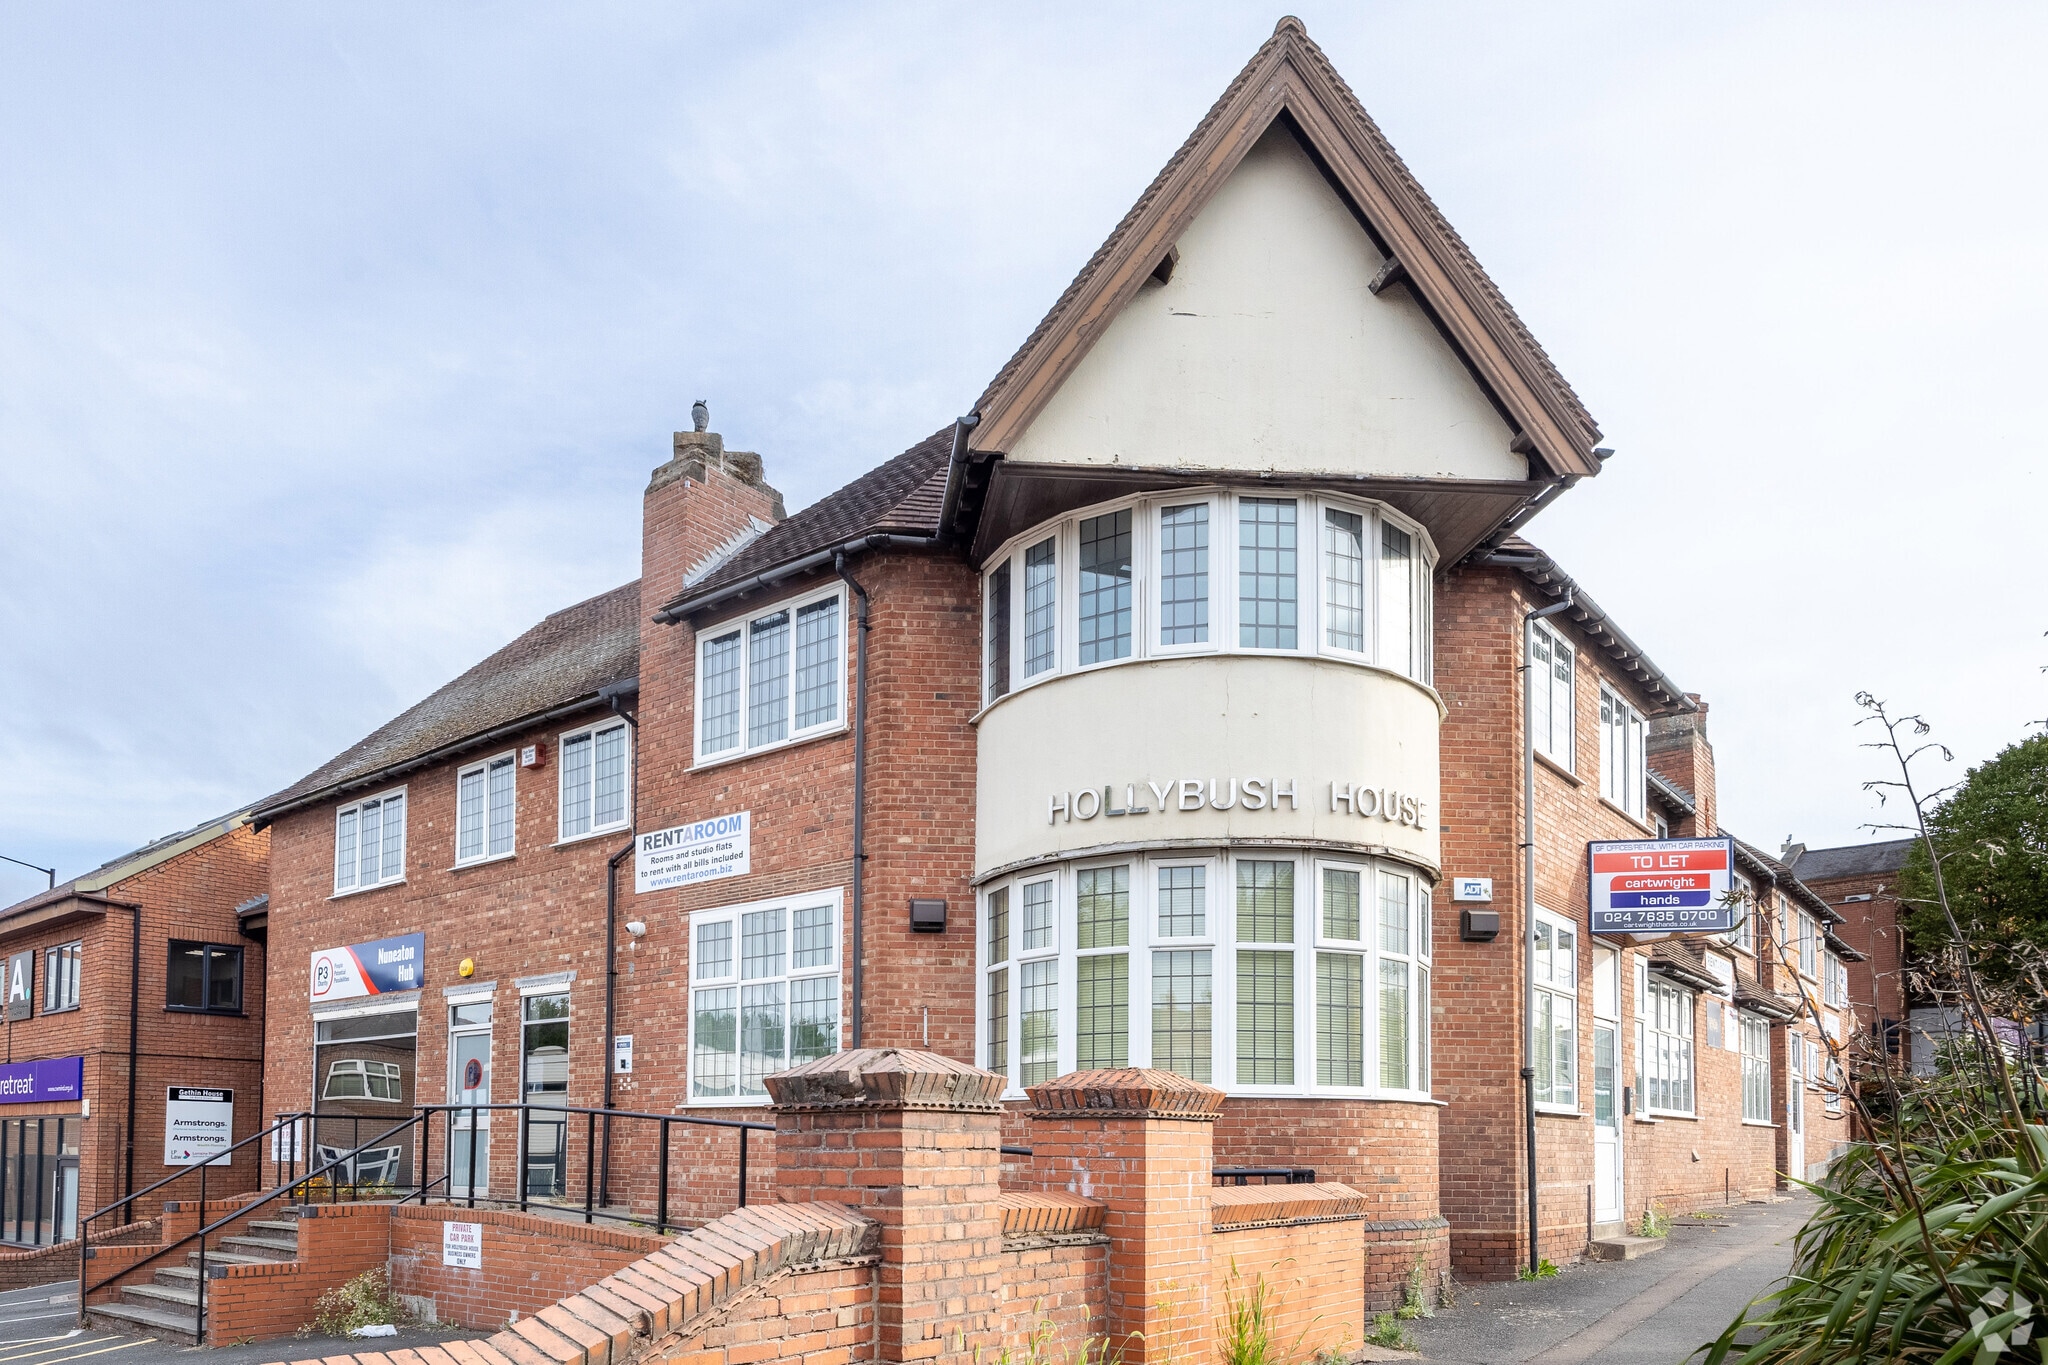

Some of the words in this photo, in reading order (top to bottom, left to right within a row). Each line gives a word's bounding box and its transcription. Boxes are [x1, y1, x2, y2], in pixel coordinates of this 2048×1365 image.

[1047, 777, 1298, 826] HOLLYBUSH
[1329, 780, 1428, 831] HOUSE
[643, 815, 742, 851] RENTAROOM
[1695, 841, 1725, 849] PARKING
[650, 854, 674, 865] Rooms
[675, 850, 689, 860] and
[691, 846, 714, 857] studio
[716, 842, 733, 852] flats
[649, 867, 664, 877] rent
[666, 863, 681, 873] with
[683, 860, 692, 870] all
[694, 857, 709, 868] bills
[711, 850, 744, 865] included
[1630, 855, 1653, 869] TO
[1659, 854, 1690, 868] LET
[650, 864, 733, 887] www.rentaroom.biz
[1464, 884, 1482, 895] ADT
[1625, 877, 1695, 890] cartwright
[1640, 894, 1680, 905] hands
[1604, 913, 1632, 923] 024
[1638, 911, 1675, 921] 7635
[1680, 911, 1717, 921] 0700
[1623, 921, 1698, 929] cartwrighthands.co.uk
[377, 945, 415, 965] Nuneaton
[317, 966, 329, 980] P3
[398, 964, 414, 982] Hub
[0, 1073, 34, 1095] retreat
[173, 1119, 228, 1128] Armstrongs.
[172, 1134, 227, 1143] Armstrongs.
[452, 1224, 472, 1233] PRIVATE
[450, 1233, 460, 1241] CAR
[461, 1234, 475, 1243] PARK
